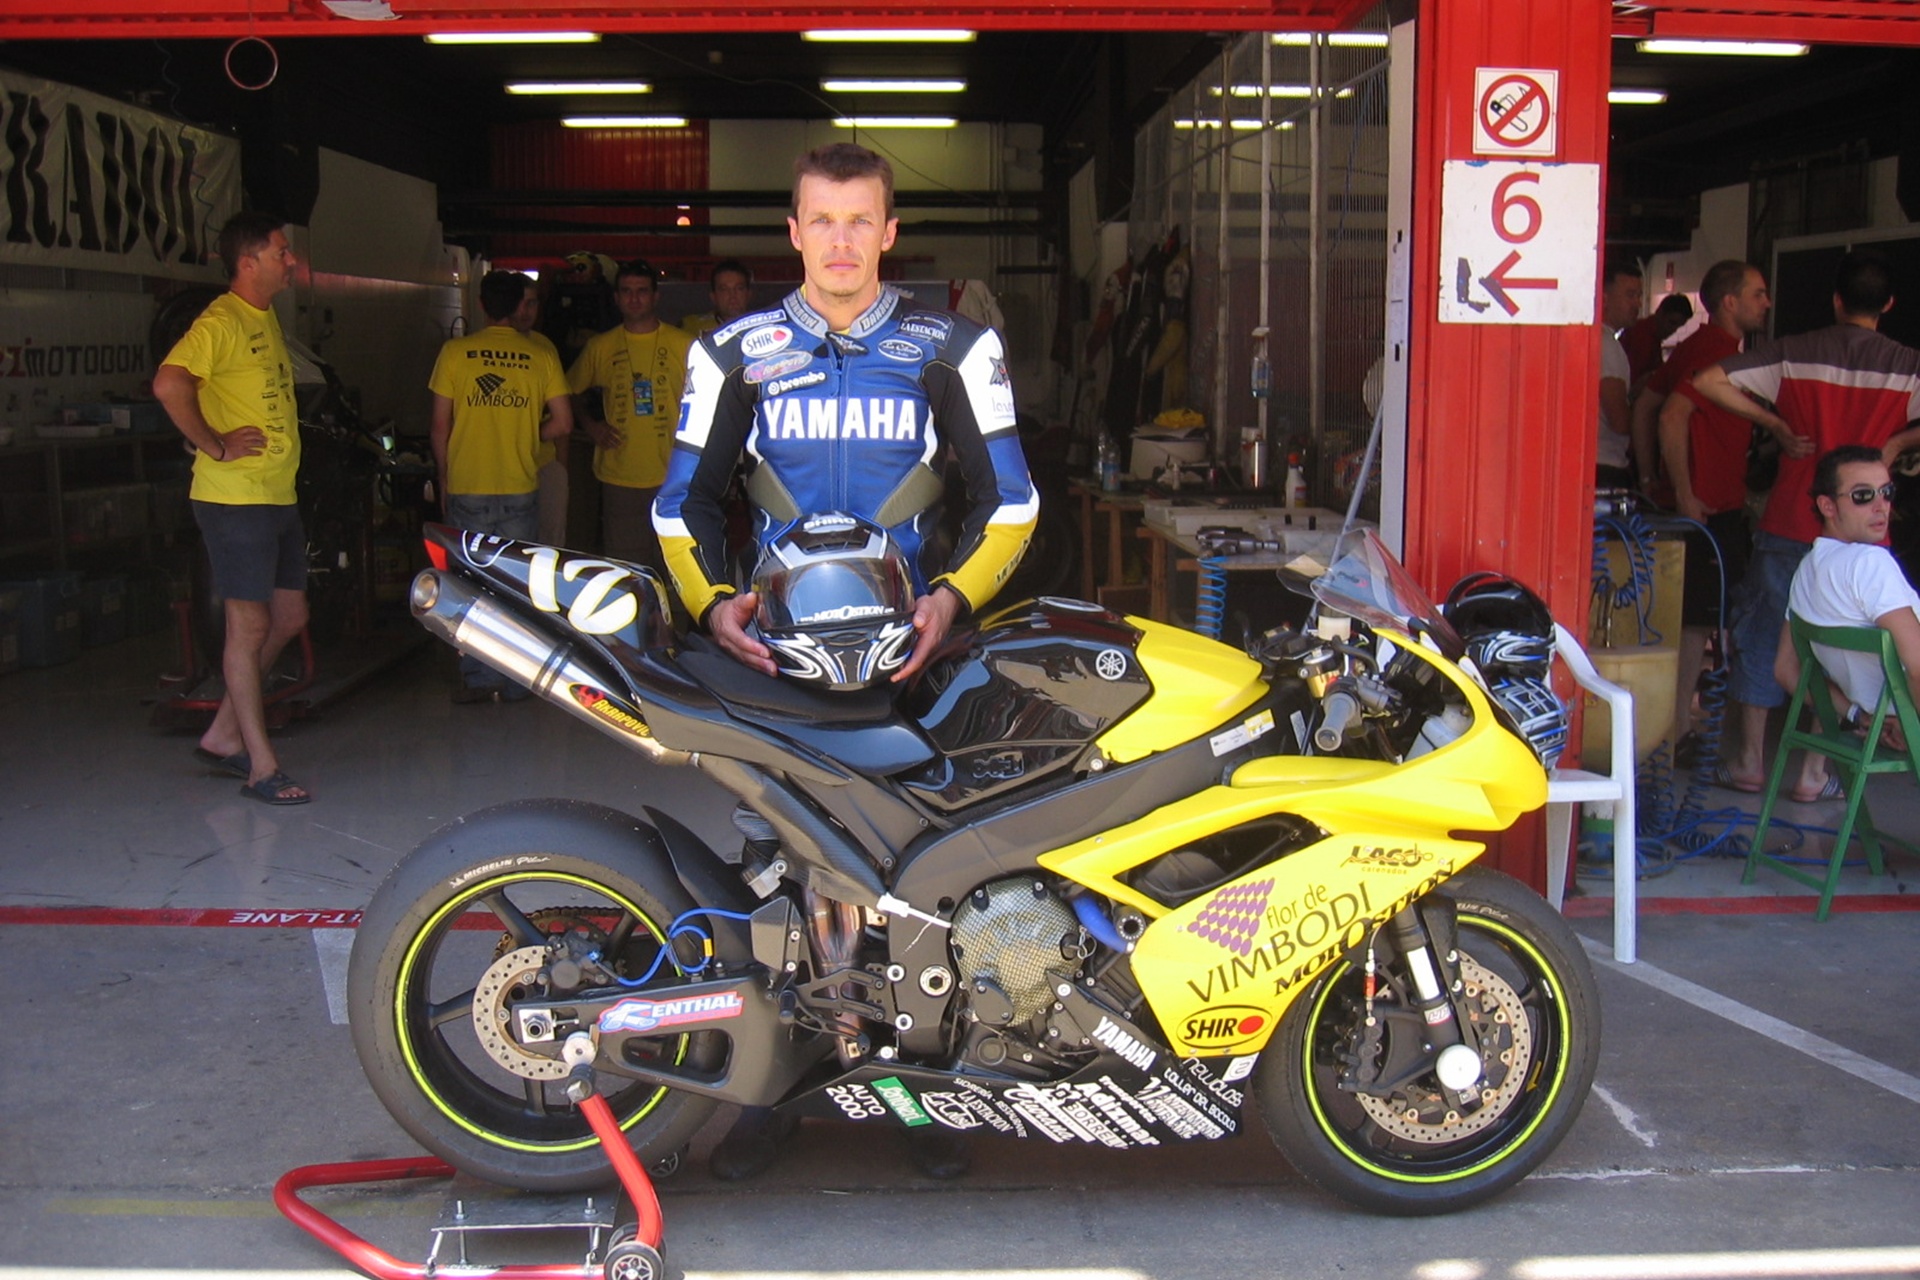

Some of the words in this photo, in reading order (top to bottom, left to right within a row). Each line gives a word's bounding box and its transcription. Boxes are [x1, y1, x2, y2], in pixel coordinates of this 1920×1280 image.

[1491, 171, 1542, 244] 6
[466, 349, 532, 361] EQUIP
[482, 359, 496, 367] 24
[778, 371, 826, 391] brembo
[466, 394, 530, 409] VIMBODI
[762, 398, 917, 440] YAMAHA
[803, 516, 858, 530] SHIRO
[522, 546, 638, 635] 12
[463, 858, 514, 881] MICHELIN
[228, 911, 361, 923] IT-LANE
[1266, 900, 1300, 930] flor
[1303, 883, 1329, 911] de
[1187, 881, 1373, 1004] VIMBODI
[1091, 1015, 1157, 1072] YAMAHA
[825, 1085, 869, 1120] 2000
[846, 1083, 887, 1116] AUTO
[1073, 1082, 1161, 1146] Adizmar
